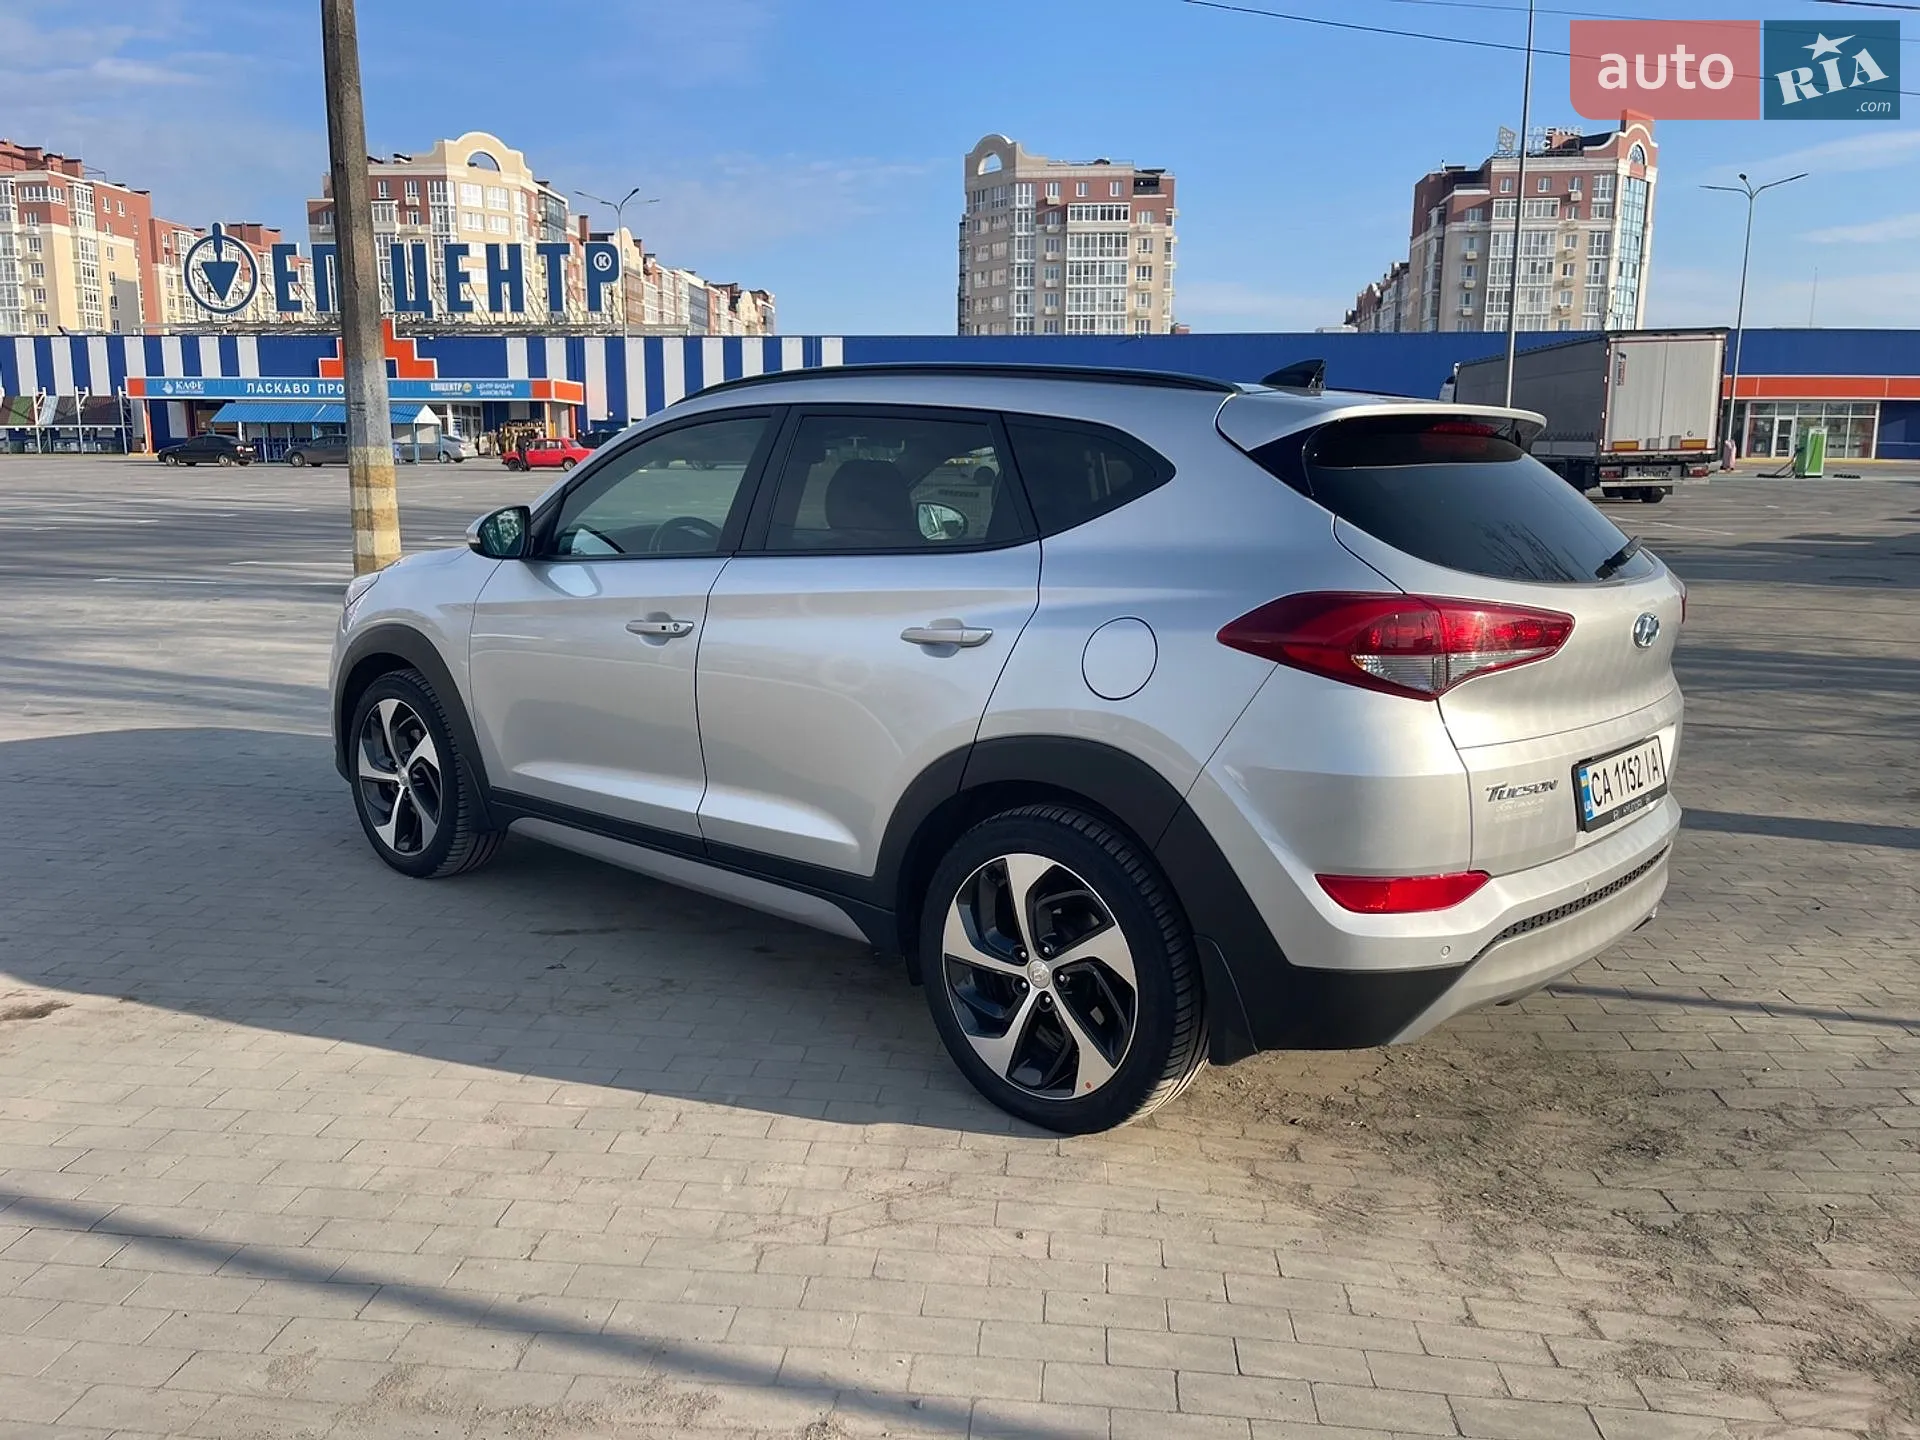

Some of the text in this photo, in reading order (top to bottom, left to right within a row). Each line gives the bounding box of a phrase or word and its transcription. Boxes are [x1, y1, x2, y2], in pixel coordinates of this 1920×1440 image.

[271, 242, 623, 318] ЕПЦЕНТР
[175, 380, 204, 391] КАФЕ
[246, 382, 310, 394] ЛАСКАВО
[1591, 747, 1660, 807] CA 1152 IA
